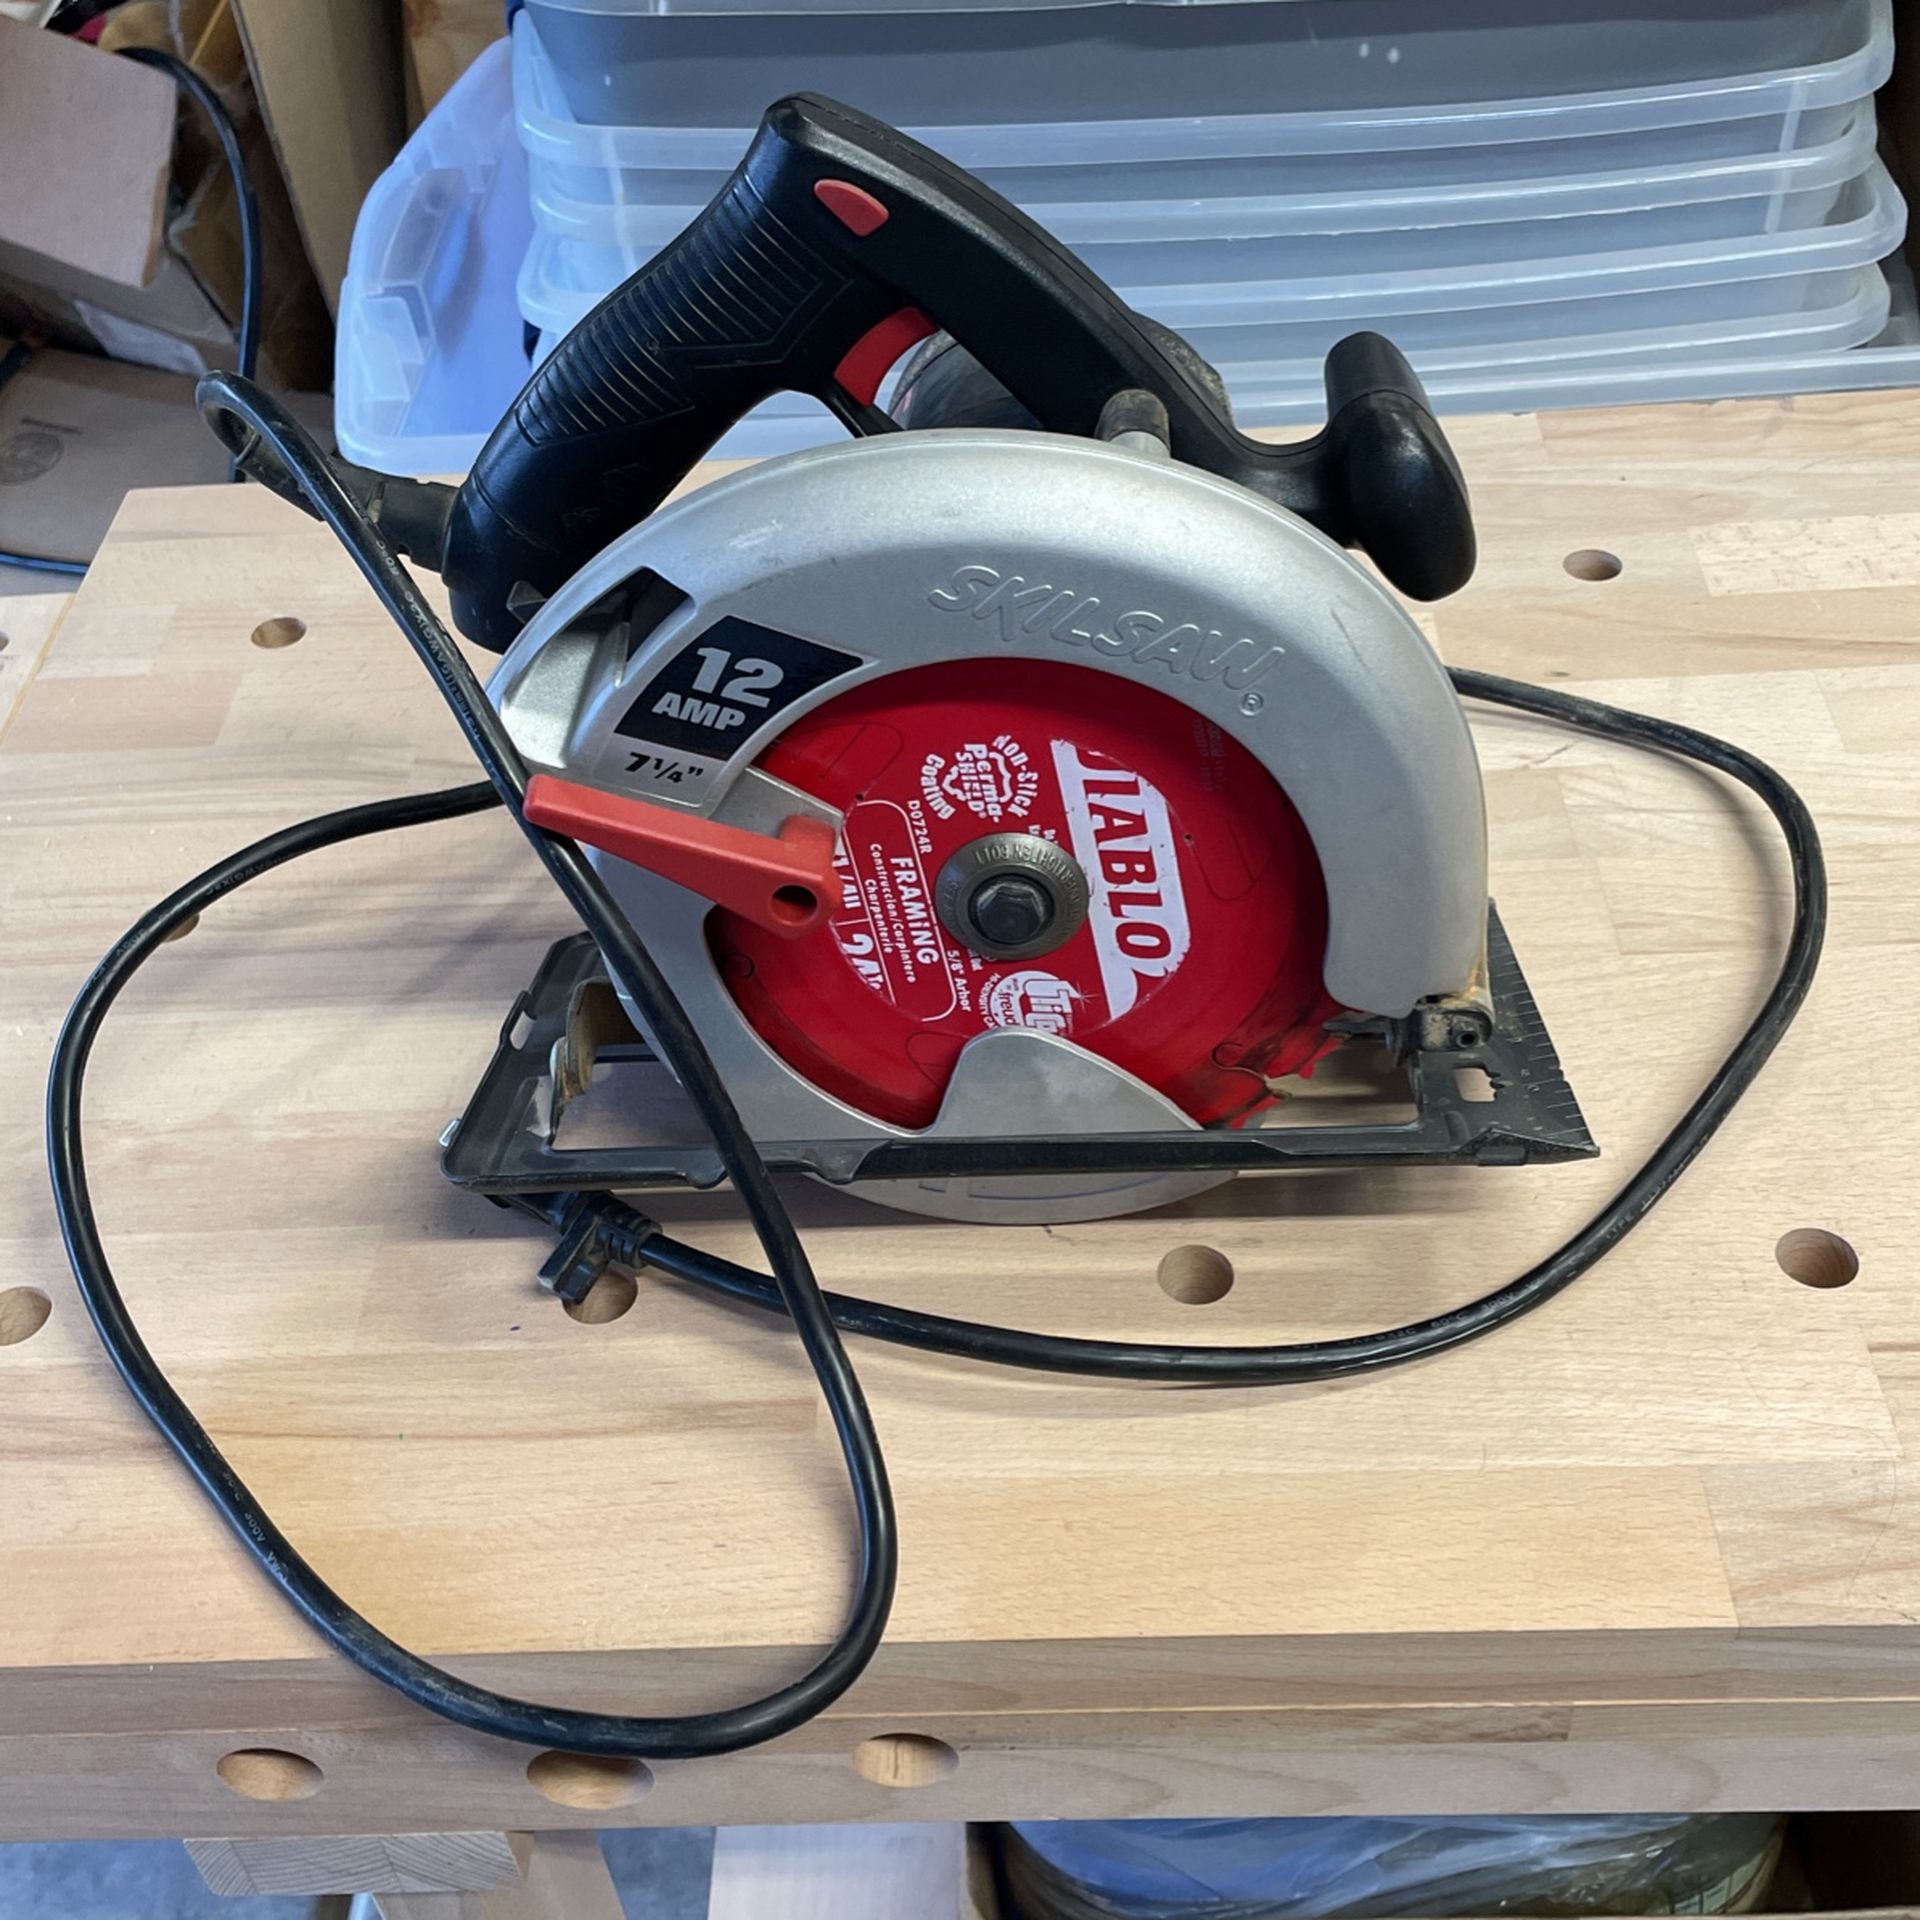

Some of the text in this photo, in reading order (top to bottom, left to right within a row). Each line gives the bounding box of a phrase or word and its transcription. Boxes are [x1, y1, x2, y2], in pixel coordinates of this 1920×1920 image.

[928, 565, 1285, 690] SKILSAW
[692, 647, 784, 709] 12
[652, 692, 746, 731] AMP
[921, 754, 956, 820] Coating
[907, 800, 933, 854] D0724R
[864, 879, 893, 953] Charpenterie
[998, 992, 1020, 1026] freud
